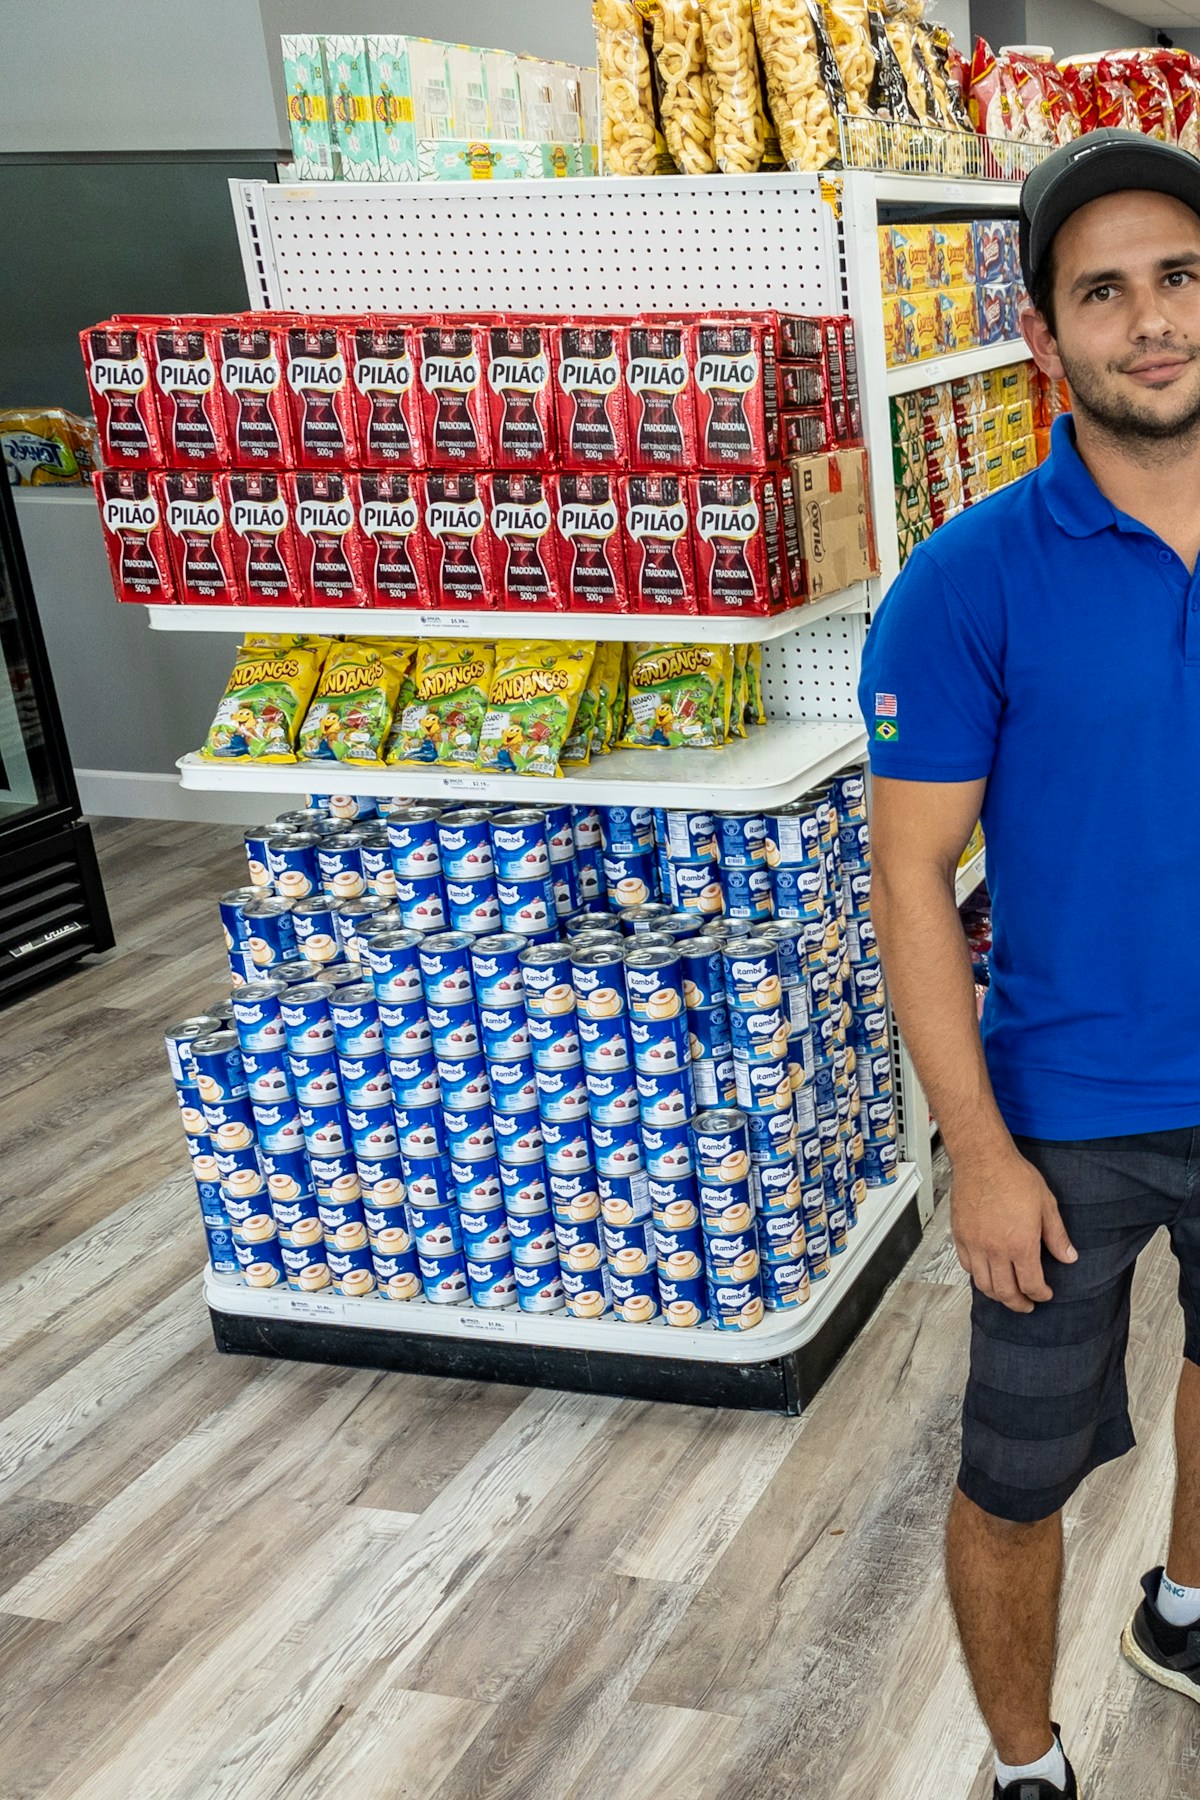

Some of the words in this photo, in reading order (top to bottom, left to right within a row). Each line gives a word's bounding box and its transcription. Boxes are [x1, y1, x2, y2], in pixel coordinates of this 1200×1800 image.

[94, 363, 144, 386] PILÃO
[160, 364, 210, 386] PILÃO
[225, 362, 276, 386] PILÃO
[291, 363, 342, 386] PILÃO
[357, 364, 408, 386] PILÃO
[424, 361, 476, 385] PILÃO
[492, 360, 545, 385] PILÃO
[562, 361, 616, 386] PILÃO
[630, 361, 684, 386] PILÃO
[699, 360, 754, 384] PILÃO
[122, 447, 139, 458] 500g
[189, 448, 204, 459] 500g
[252, 448, 269, 458] 500g
[317, 448, 333, 458] 500g
[383, 448, 399, 459] 500g
[515, 449, 532, 459] 500g
[653, 450, 669, 460] 500g
[721, 450, 738, 460] 500g
[108, 503, 155, 526] PILÃO
[171, 503, 220, 526] PILÃO
[234, 504, 284, 526] PILÃO
[300, 504, 351, 527] PILÃO
[364, 505, 412, 527] PILÃO
[429, 504, 480, 528] PILÃO
[495, 505, 547, 530] PILÃO
[562, 506, 614, 531] PILÃO
[700, 507, 755, 531] PILÃO
[630, 509, 684, 533] PILÃO
[136, 584, 151, 594] 500g
[199, 587, 215, 596] 500g
[261, 587, 278, 597] 500g
[389, 588, 406, 598] 500g
[520, 592, 537, 602] 500g
[586, 592, 603, 602] 500g
[725, 595, 742, 606] 500g
[632, 648, 711, 686] FANDANGOS
[679, 870, 707, 883] itambé
[736, 965, 764, 976] itambé
[525, 972, 550, 984] itambé
[629, 976, 656, 988] itambé
[752, 1019, 777, 1029] itambé
[756, 1070, 781, 1082] itambé
[701, 1141, 727, 1152] itambé
[766, 1170, 791, 1181] itambé
[552, 1181, 577, 1192] itambé
[704, 1191, 728, 1202] itambé
[771, 1220, 797, 1231] itambé
[714, 1242, 739, 1252] itambé
[721, 1290, 748, 1301] itambé
